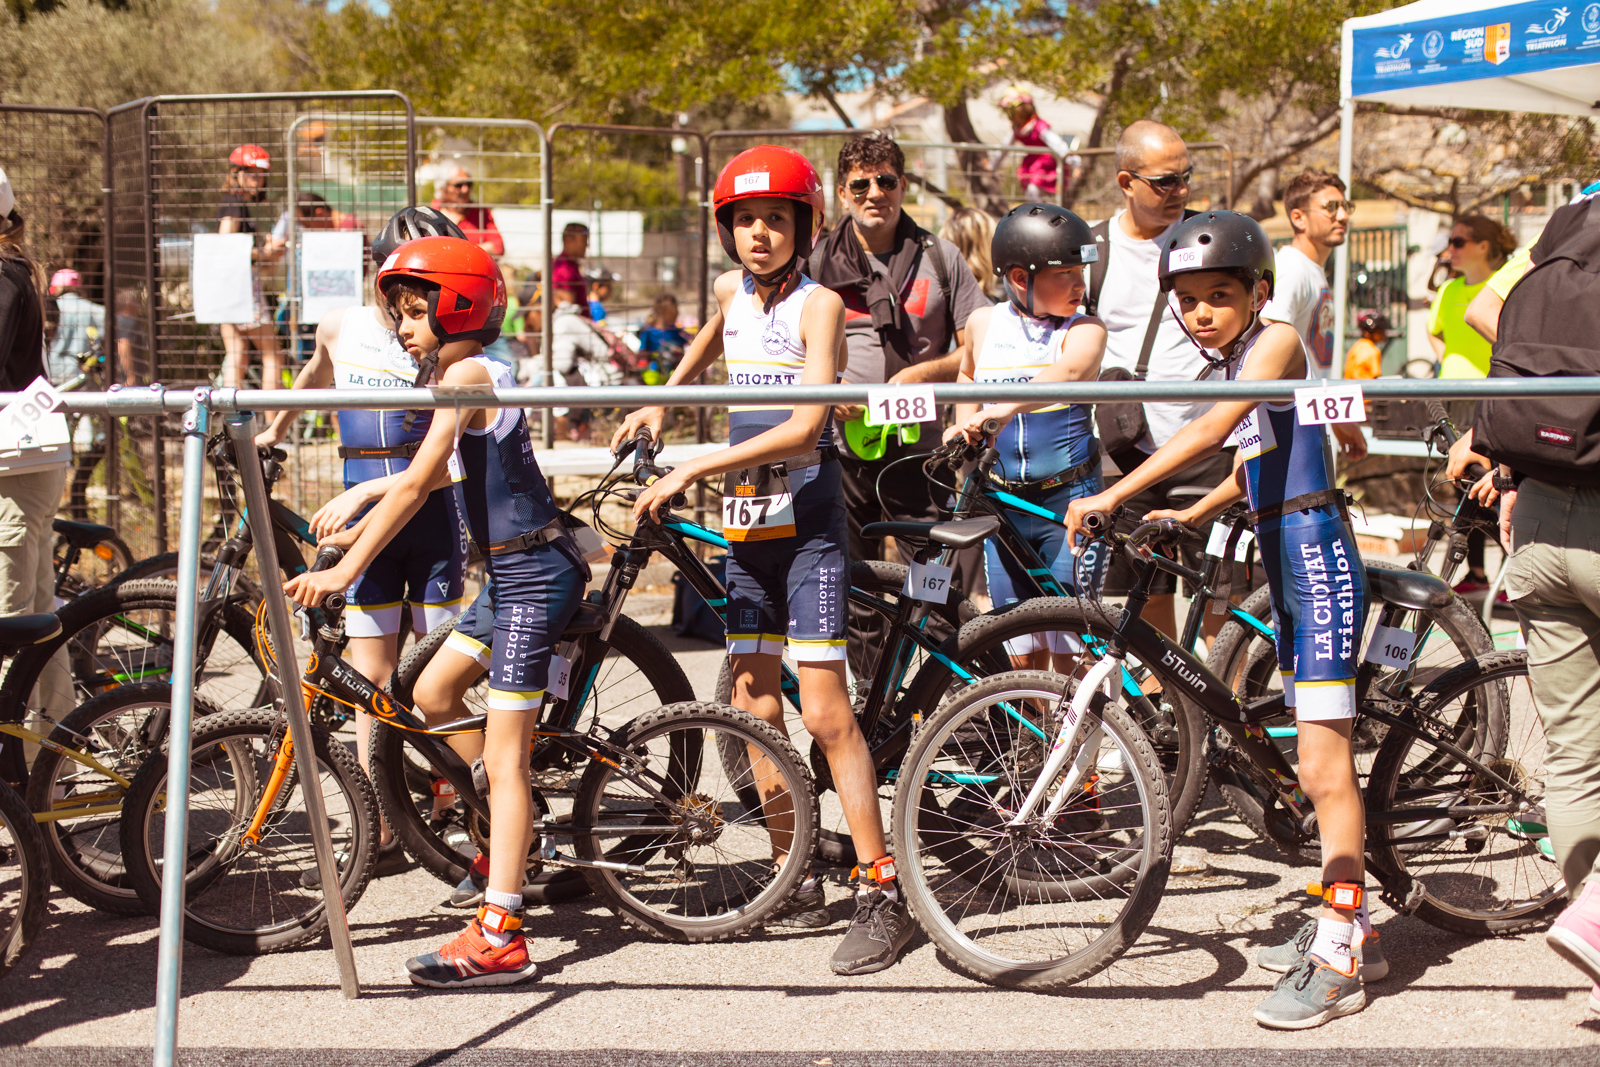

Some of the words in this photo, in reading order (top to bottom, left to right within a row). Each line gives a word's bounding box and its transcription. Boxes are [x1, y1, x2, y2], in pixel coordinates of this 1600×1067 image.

[1451, 27, 1484, 42] RÉGION
[1465, 38, 1484, 49] SUD
[1526, 38, 1567, 52] TRIATHLON
[743, 175, 760, 186] 167
[1178, 251, 1195, 262] 106
[349, 373, 365, 386] LA
[736, 373, 795, 386] CIOTAT
[11, 390, 54, 430] 190
[879, 397, 927, 420] 188
[1306, 396, 1355, 421] 187
[1540, 430, 1570, 442] EASTPAK
[726, 498, 772, 526] 167
[819, 567, 828, 614] CIOTAT
[922, 576, 946, 591] 167
[1300, 543, 1332, 625] CIOTAT
[828, 567, 836, 633] triathlon
[1331, 538, 1354, 661] triathlon
[505, 605, 523, 659] CIOTAT
[819, 617, 828, 633] LA
[515, 606, 535, 684] triathlon
[1314, 629, 1334, 661] LA
[1384, 643, 1408, 661] 106
[502, 663, 514, 683] LA
